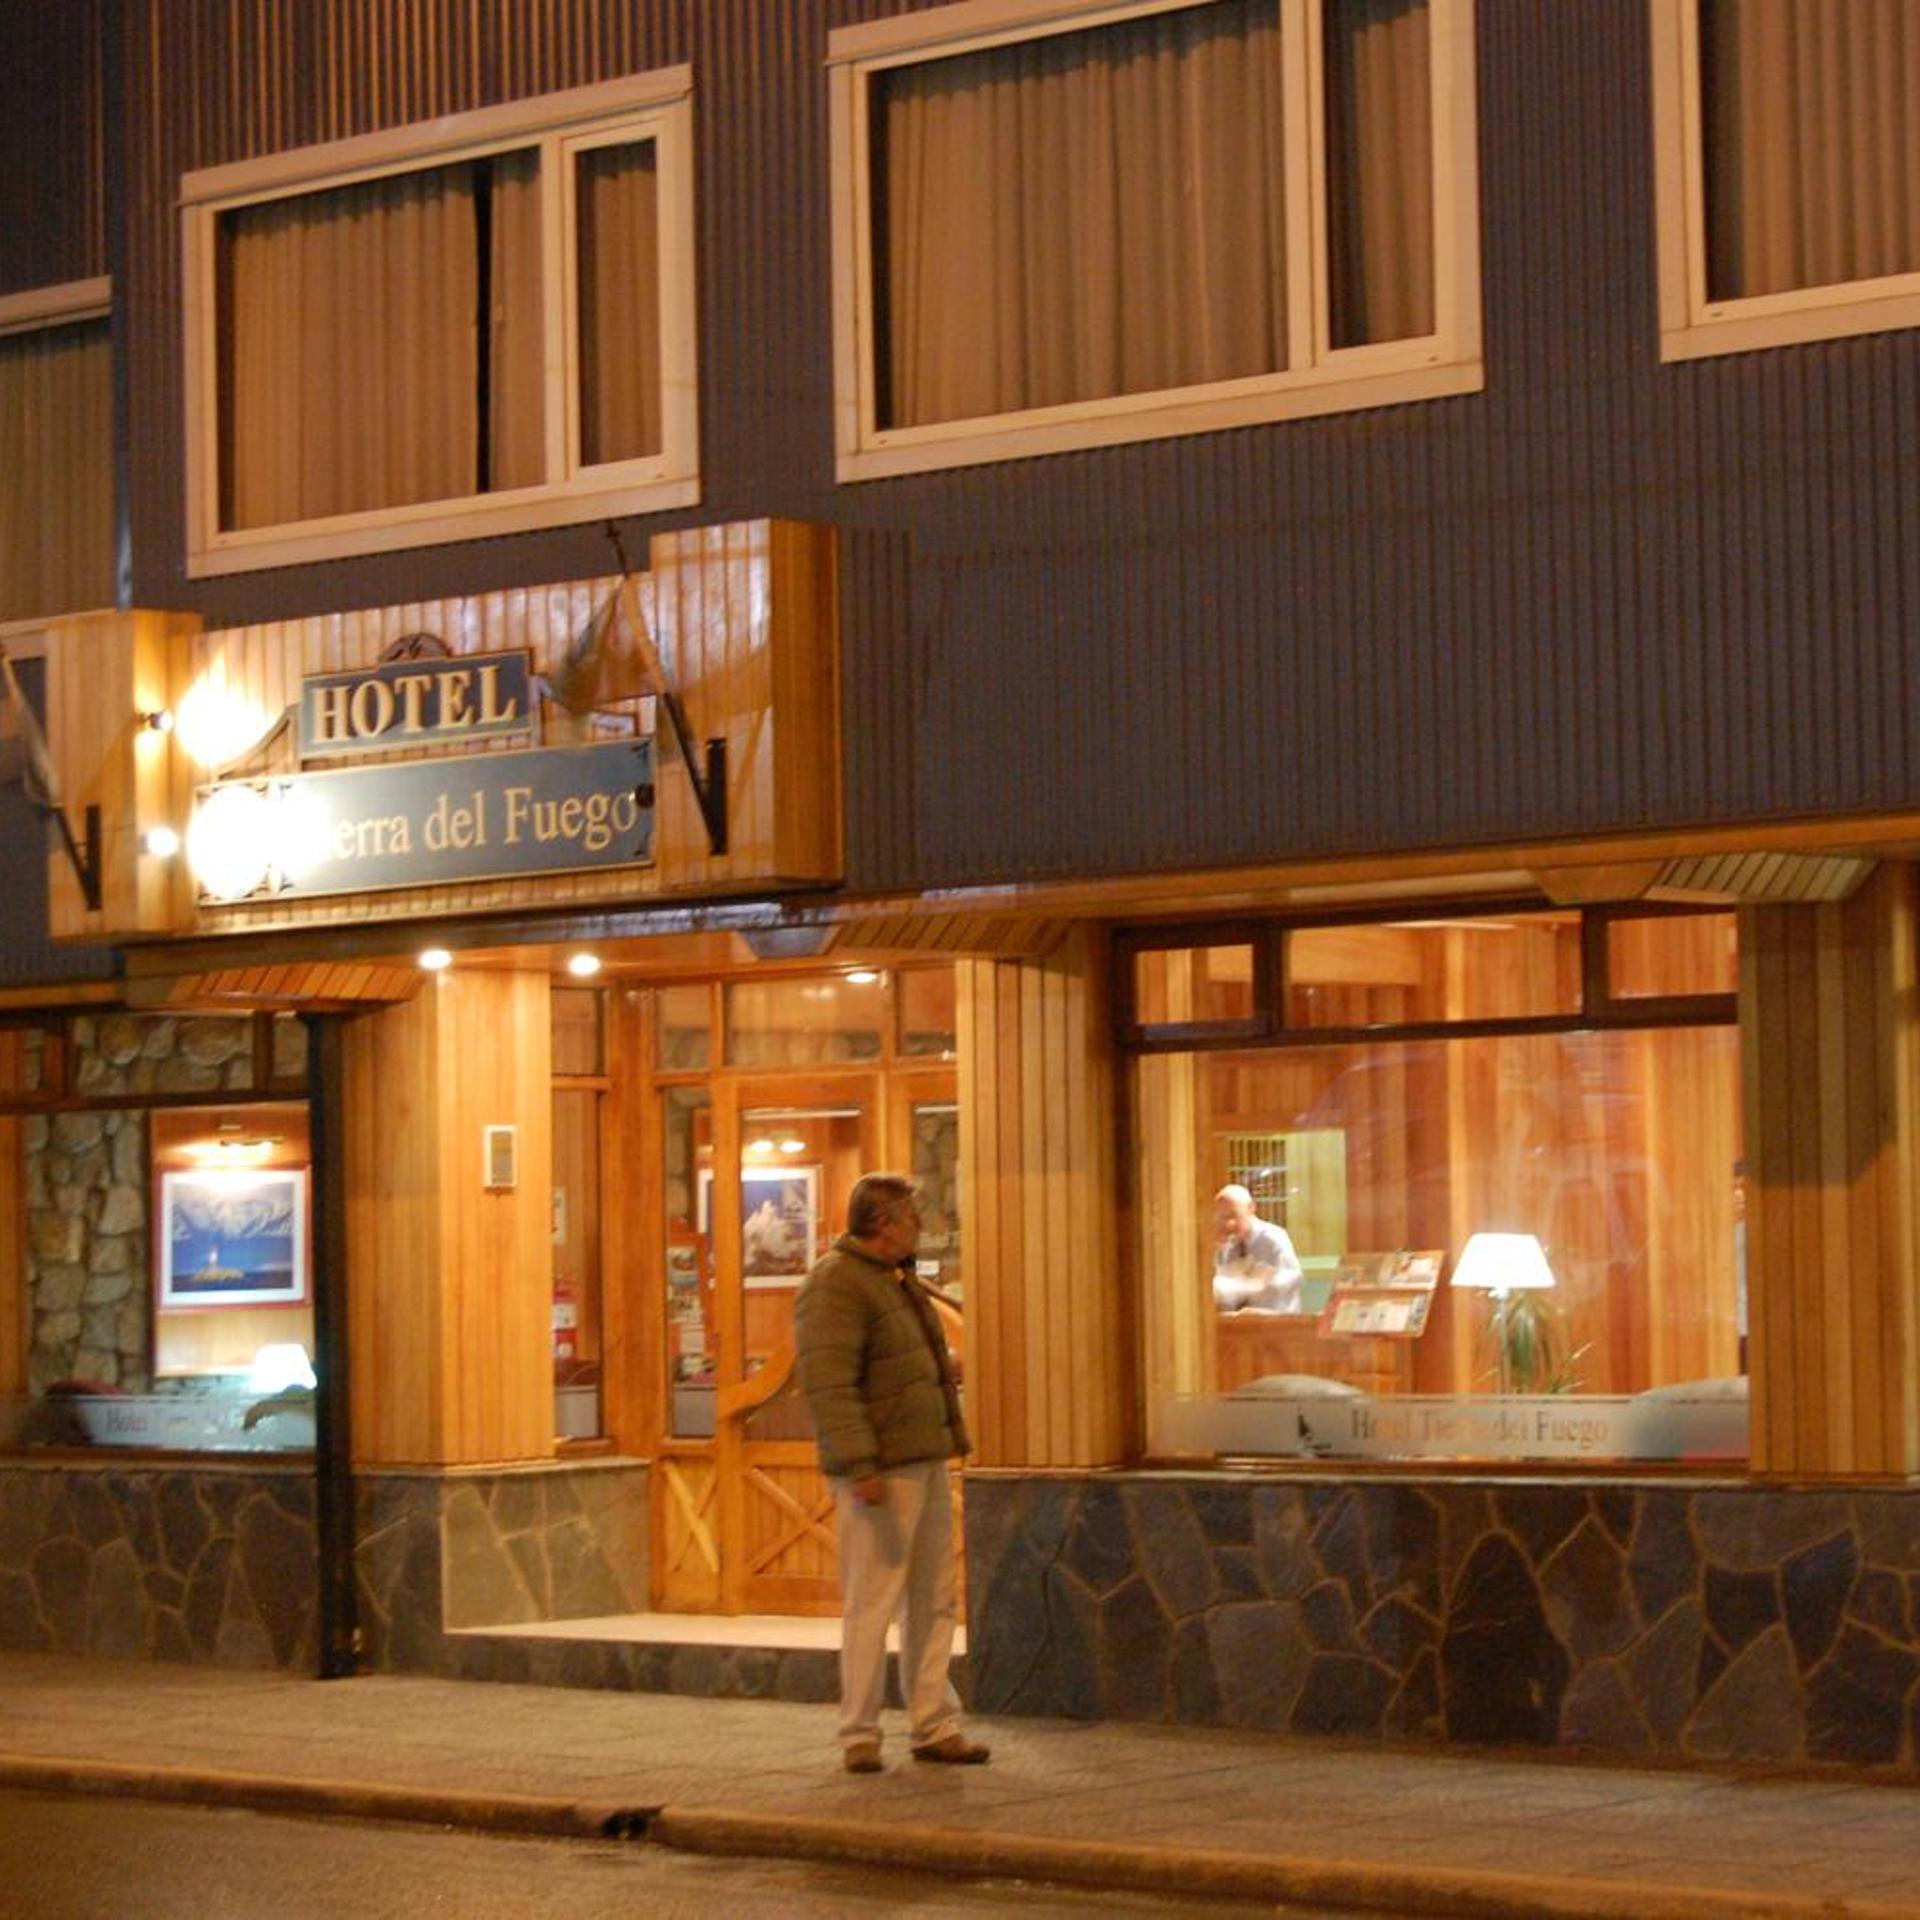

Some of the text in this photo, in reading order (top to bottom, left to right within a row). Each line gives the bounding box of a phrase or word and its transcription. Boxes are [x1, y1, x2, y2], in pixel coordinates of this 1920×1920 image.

[312, 665, 516, 744] HOTEL
[424, 790, 487, 850] del
[503, 787, 637, 851] Fuego
[1535, 1408, 1610, 1450] Fuego
